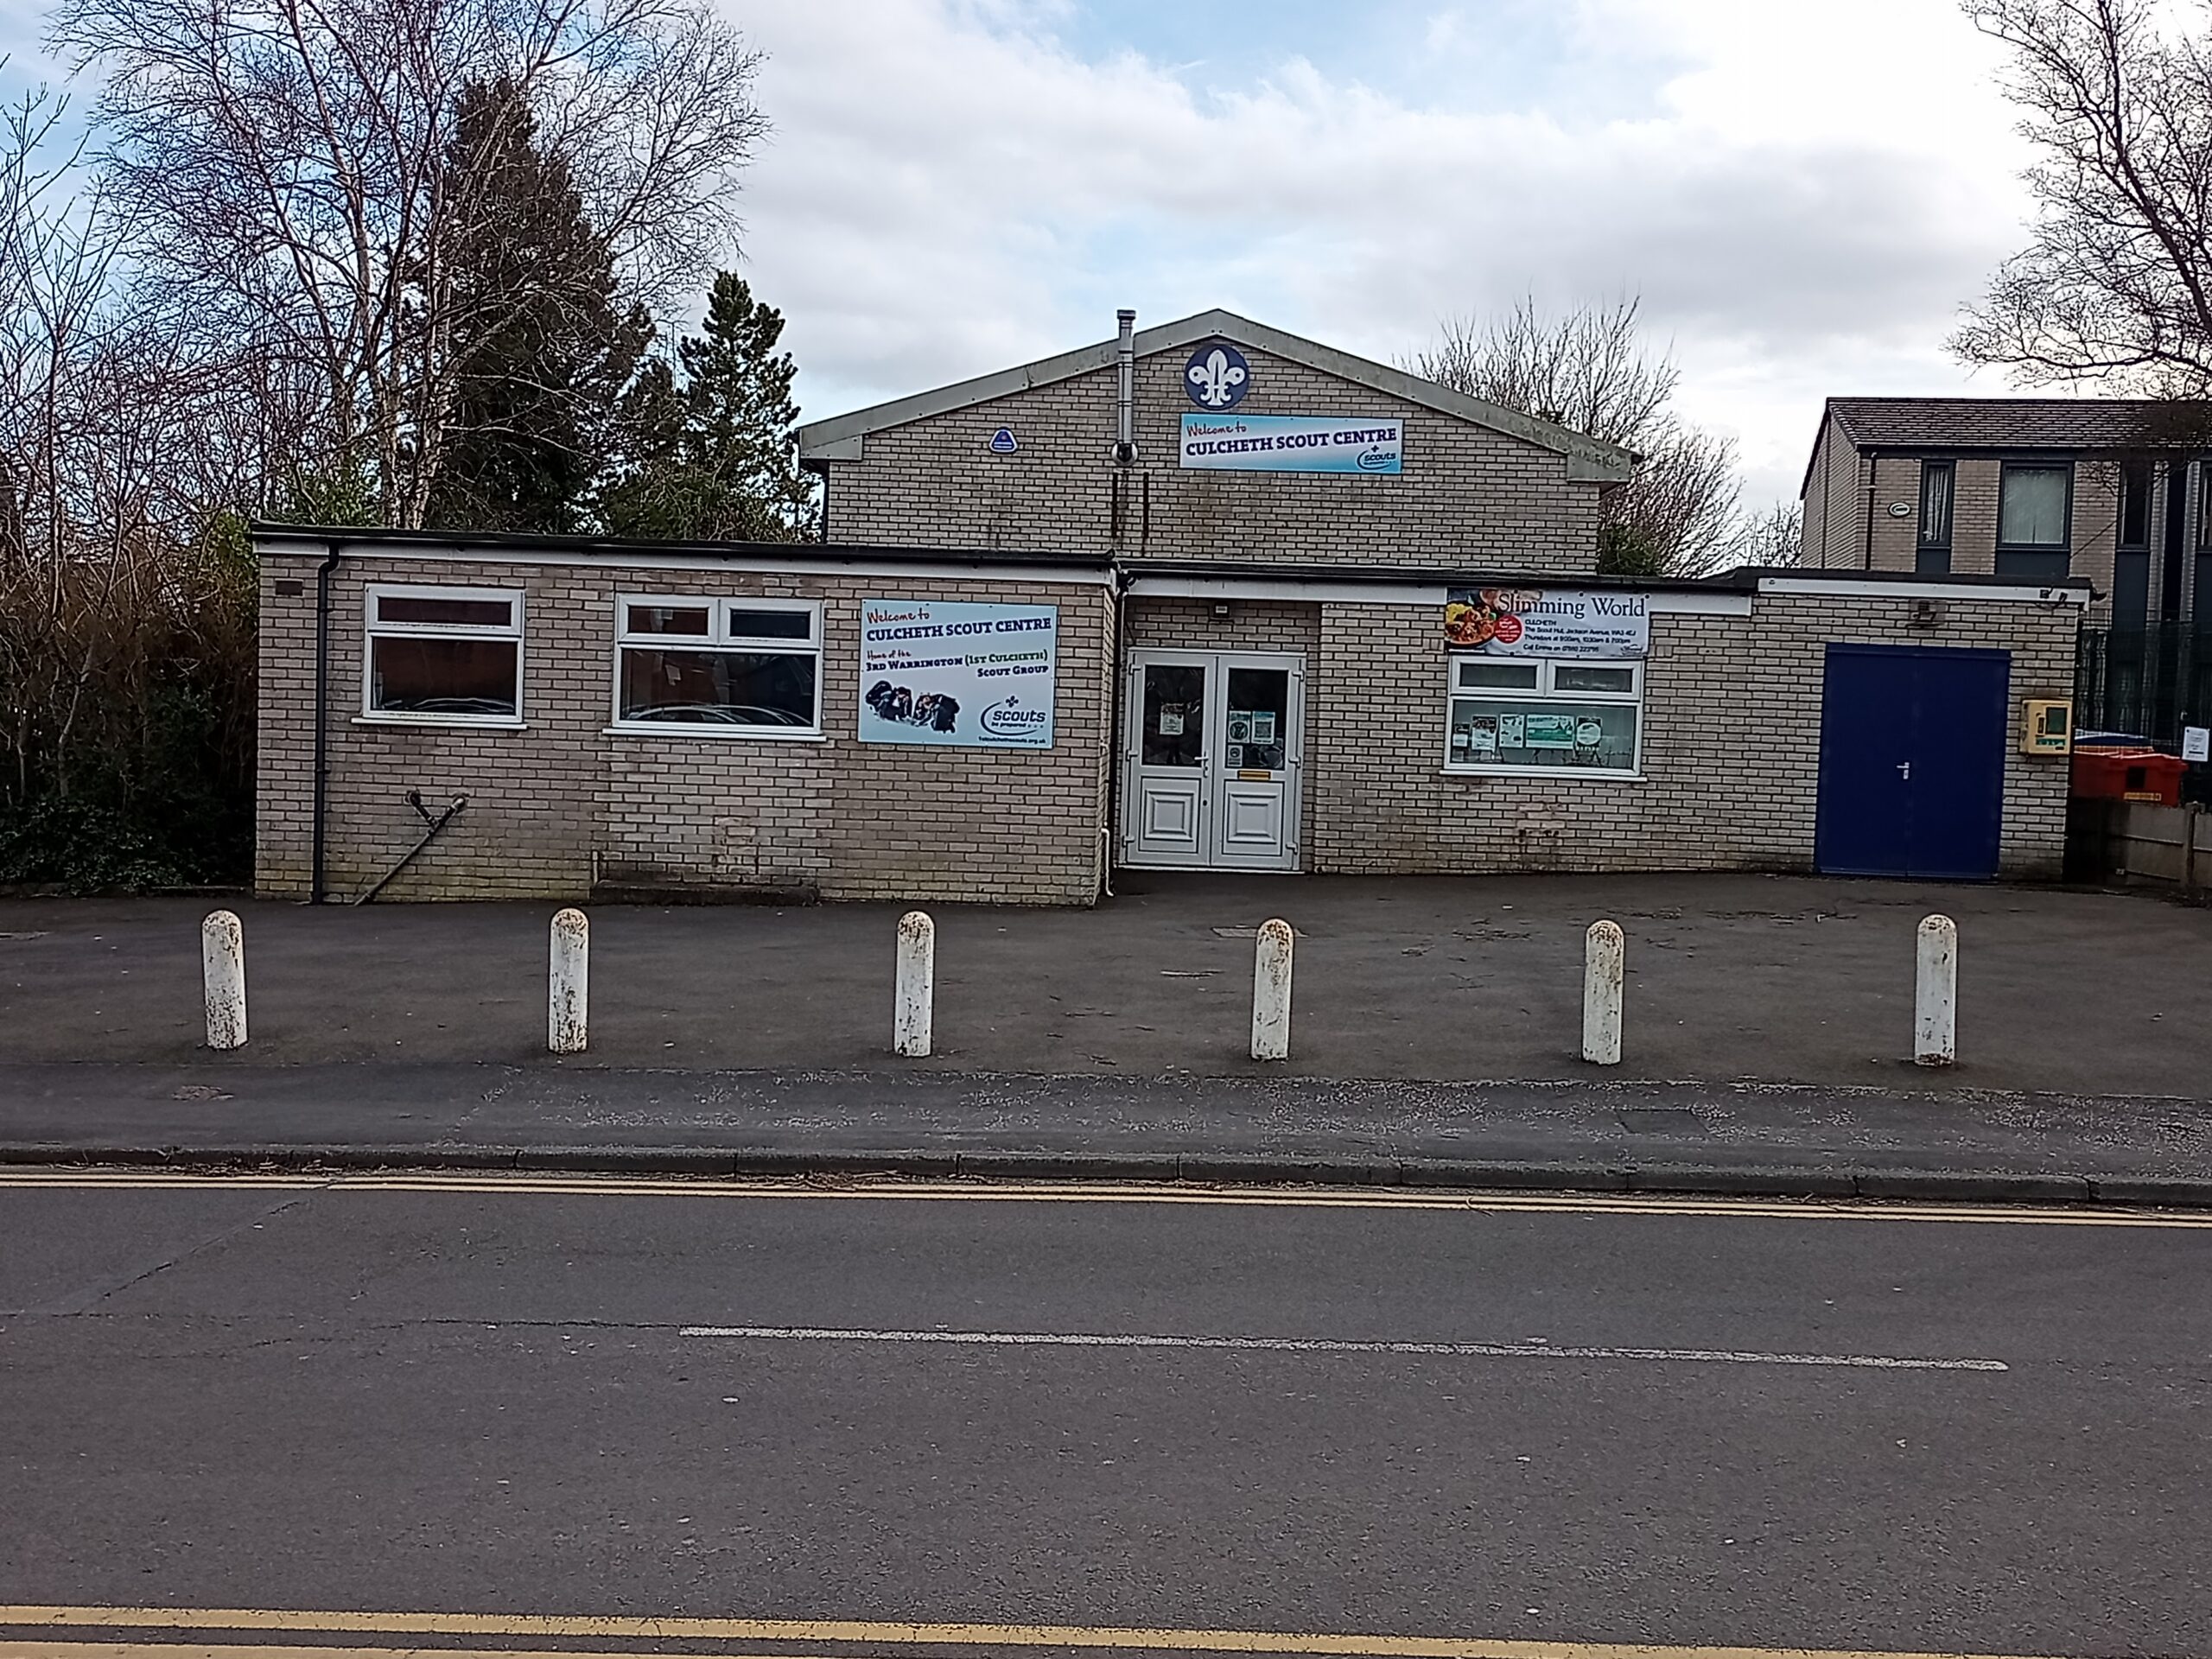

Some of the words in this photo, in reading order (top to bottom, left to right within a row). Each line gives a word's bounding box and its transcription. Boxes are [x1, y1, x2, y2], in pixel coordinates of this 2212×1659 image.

[1186, 422, 1234, 437] Welcome
[1235, 421, 1247, 433] to
[1185, 437, 1274, 456] CULCHETH
[1276, 433, 1330, 450] SCOUT
[1332, 428, 1397, 445] CENTRE
[1364, 452, 1396, 461] scouts
[1498, 593, 1586, 620] Slimming
[1591, 597, 1646, 617] World
[867, 609, 916, 624] Welcome
[917, 607, 931, 620] to
[866, 625, 944, 641] CULCHETH
[945, 621, 993, 636] SCOUT
[995, 617, 1052, 632] CENTRE
[867, 650, 887, 660] Home
[888, 650, 897, 659] of
[898, 649, 912, 658] the
[866, 661, 887, 671] 3RD
[992, 709, 1046, 722] scouts
